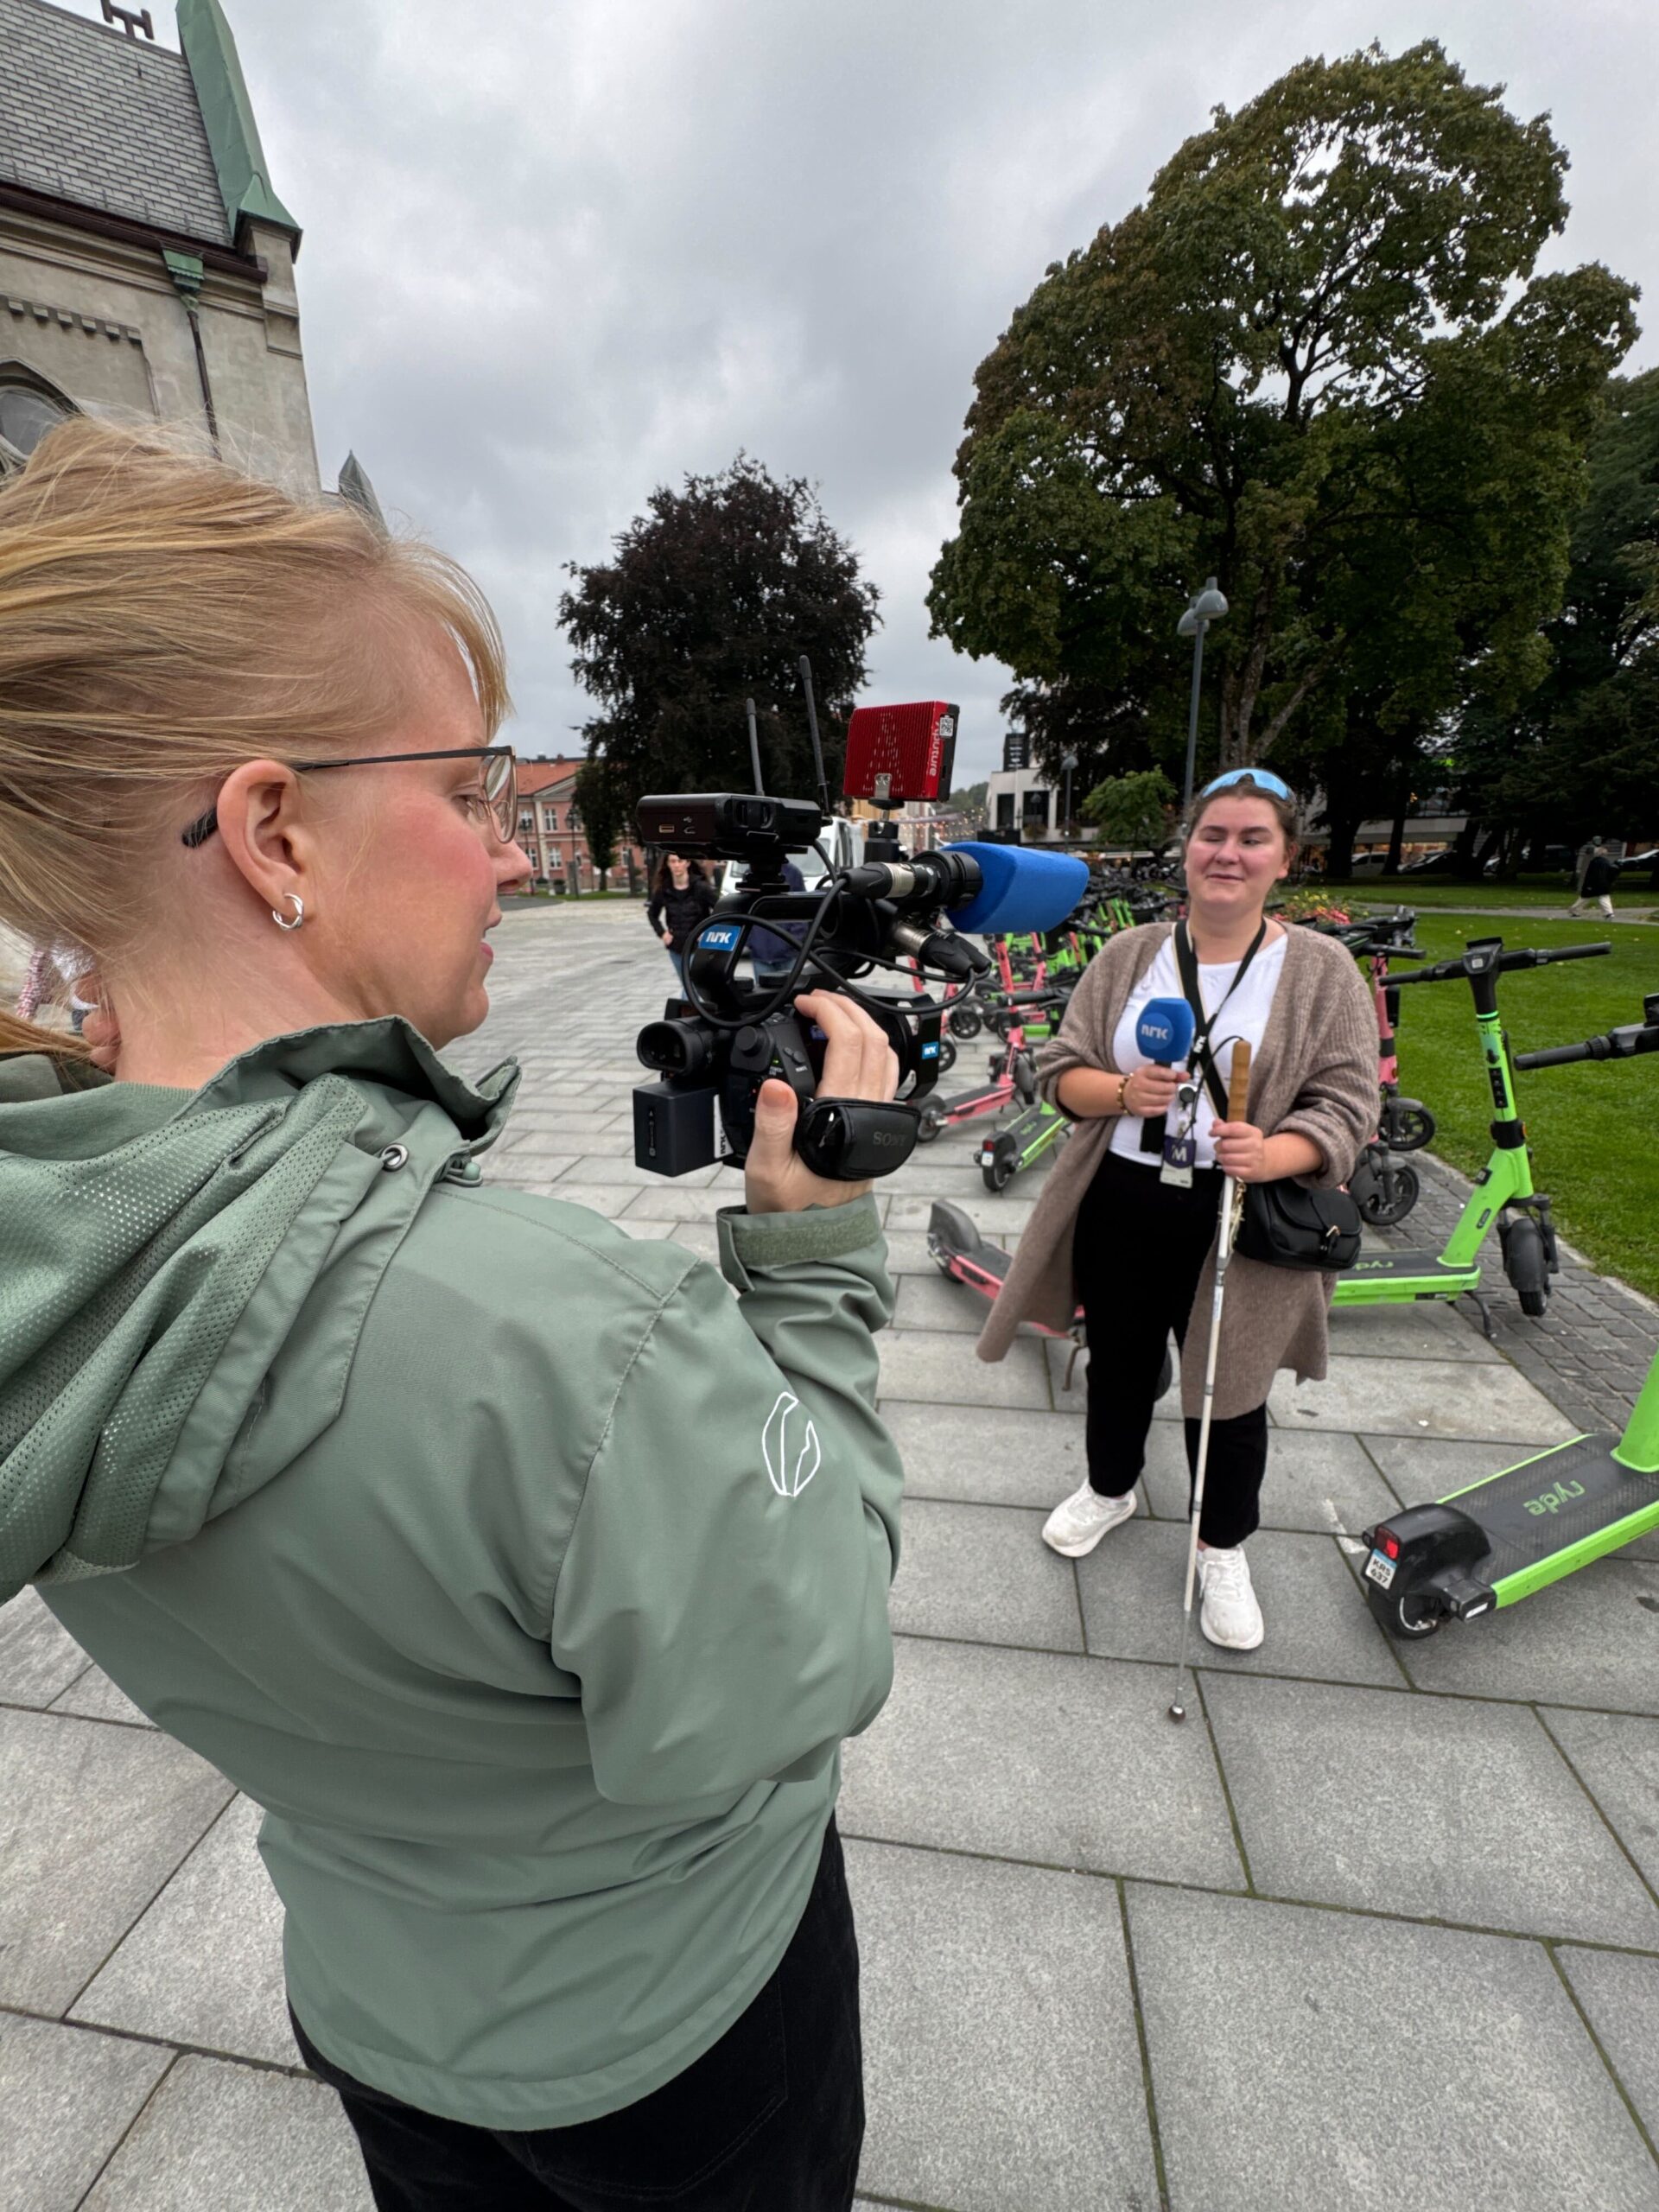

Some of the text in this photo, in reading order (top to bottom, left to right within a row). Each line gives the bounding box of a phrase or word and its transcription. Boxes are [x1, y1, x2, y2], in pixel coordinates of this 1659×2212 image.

[705, 931, 733, 944] NRK
[1141, 1024, 1169, 1040] NRK
[1352, 1261, 1394, 1270] ryd
[1522, 1479, 1586, 1516] ryde
